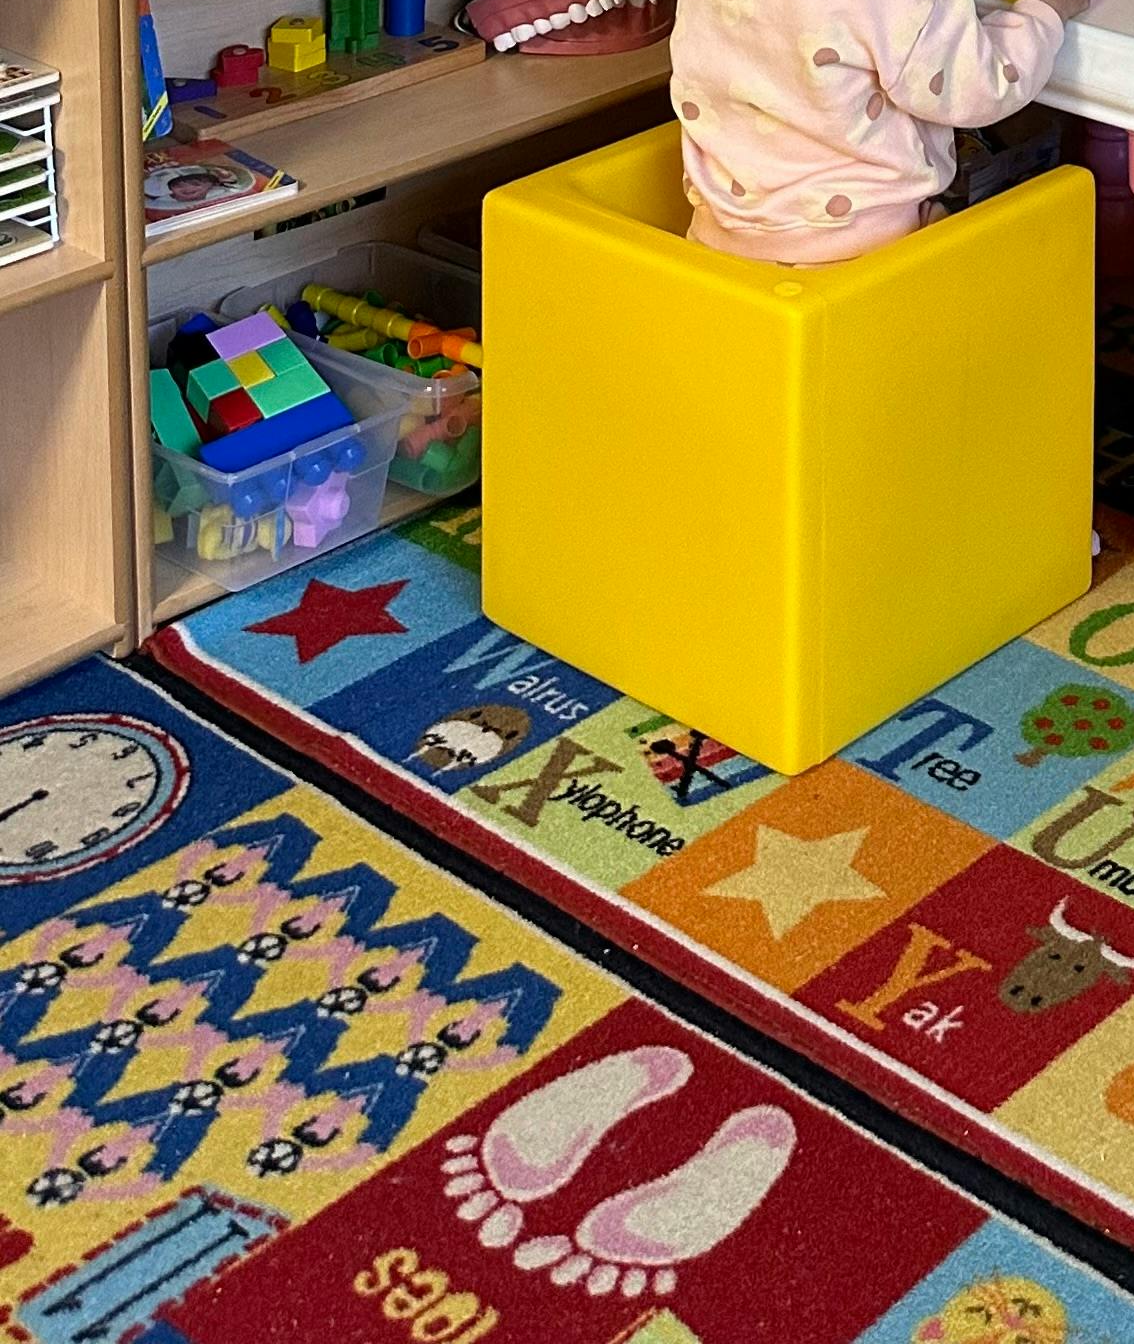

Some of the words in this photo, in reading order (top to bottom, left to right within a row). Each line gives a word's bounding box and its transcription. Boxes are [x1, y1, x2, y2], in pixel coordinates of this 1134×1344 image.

[442, 625, 590, 721] Walrus
[470, 736, 685, 857] Xylophone
[855, 698, 994, 792] Tree
[835, 923, 992, 1044] Yak
